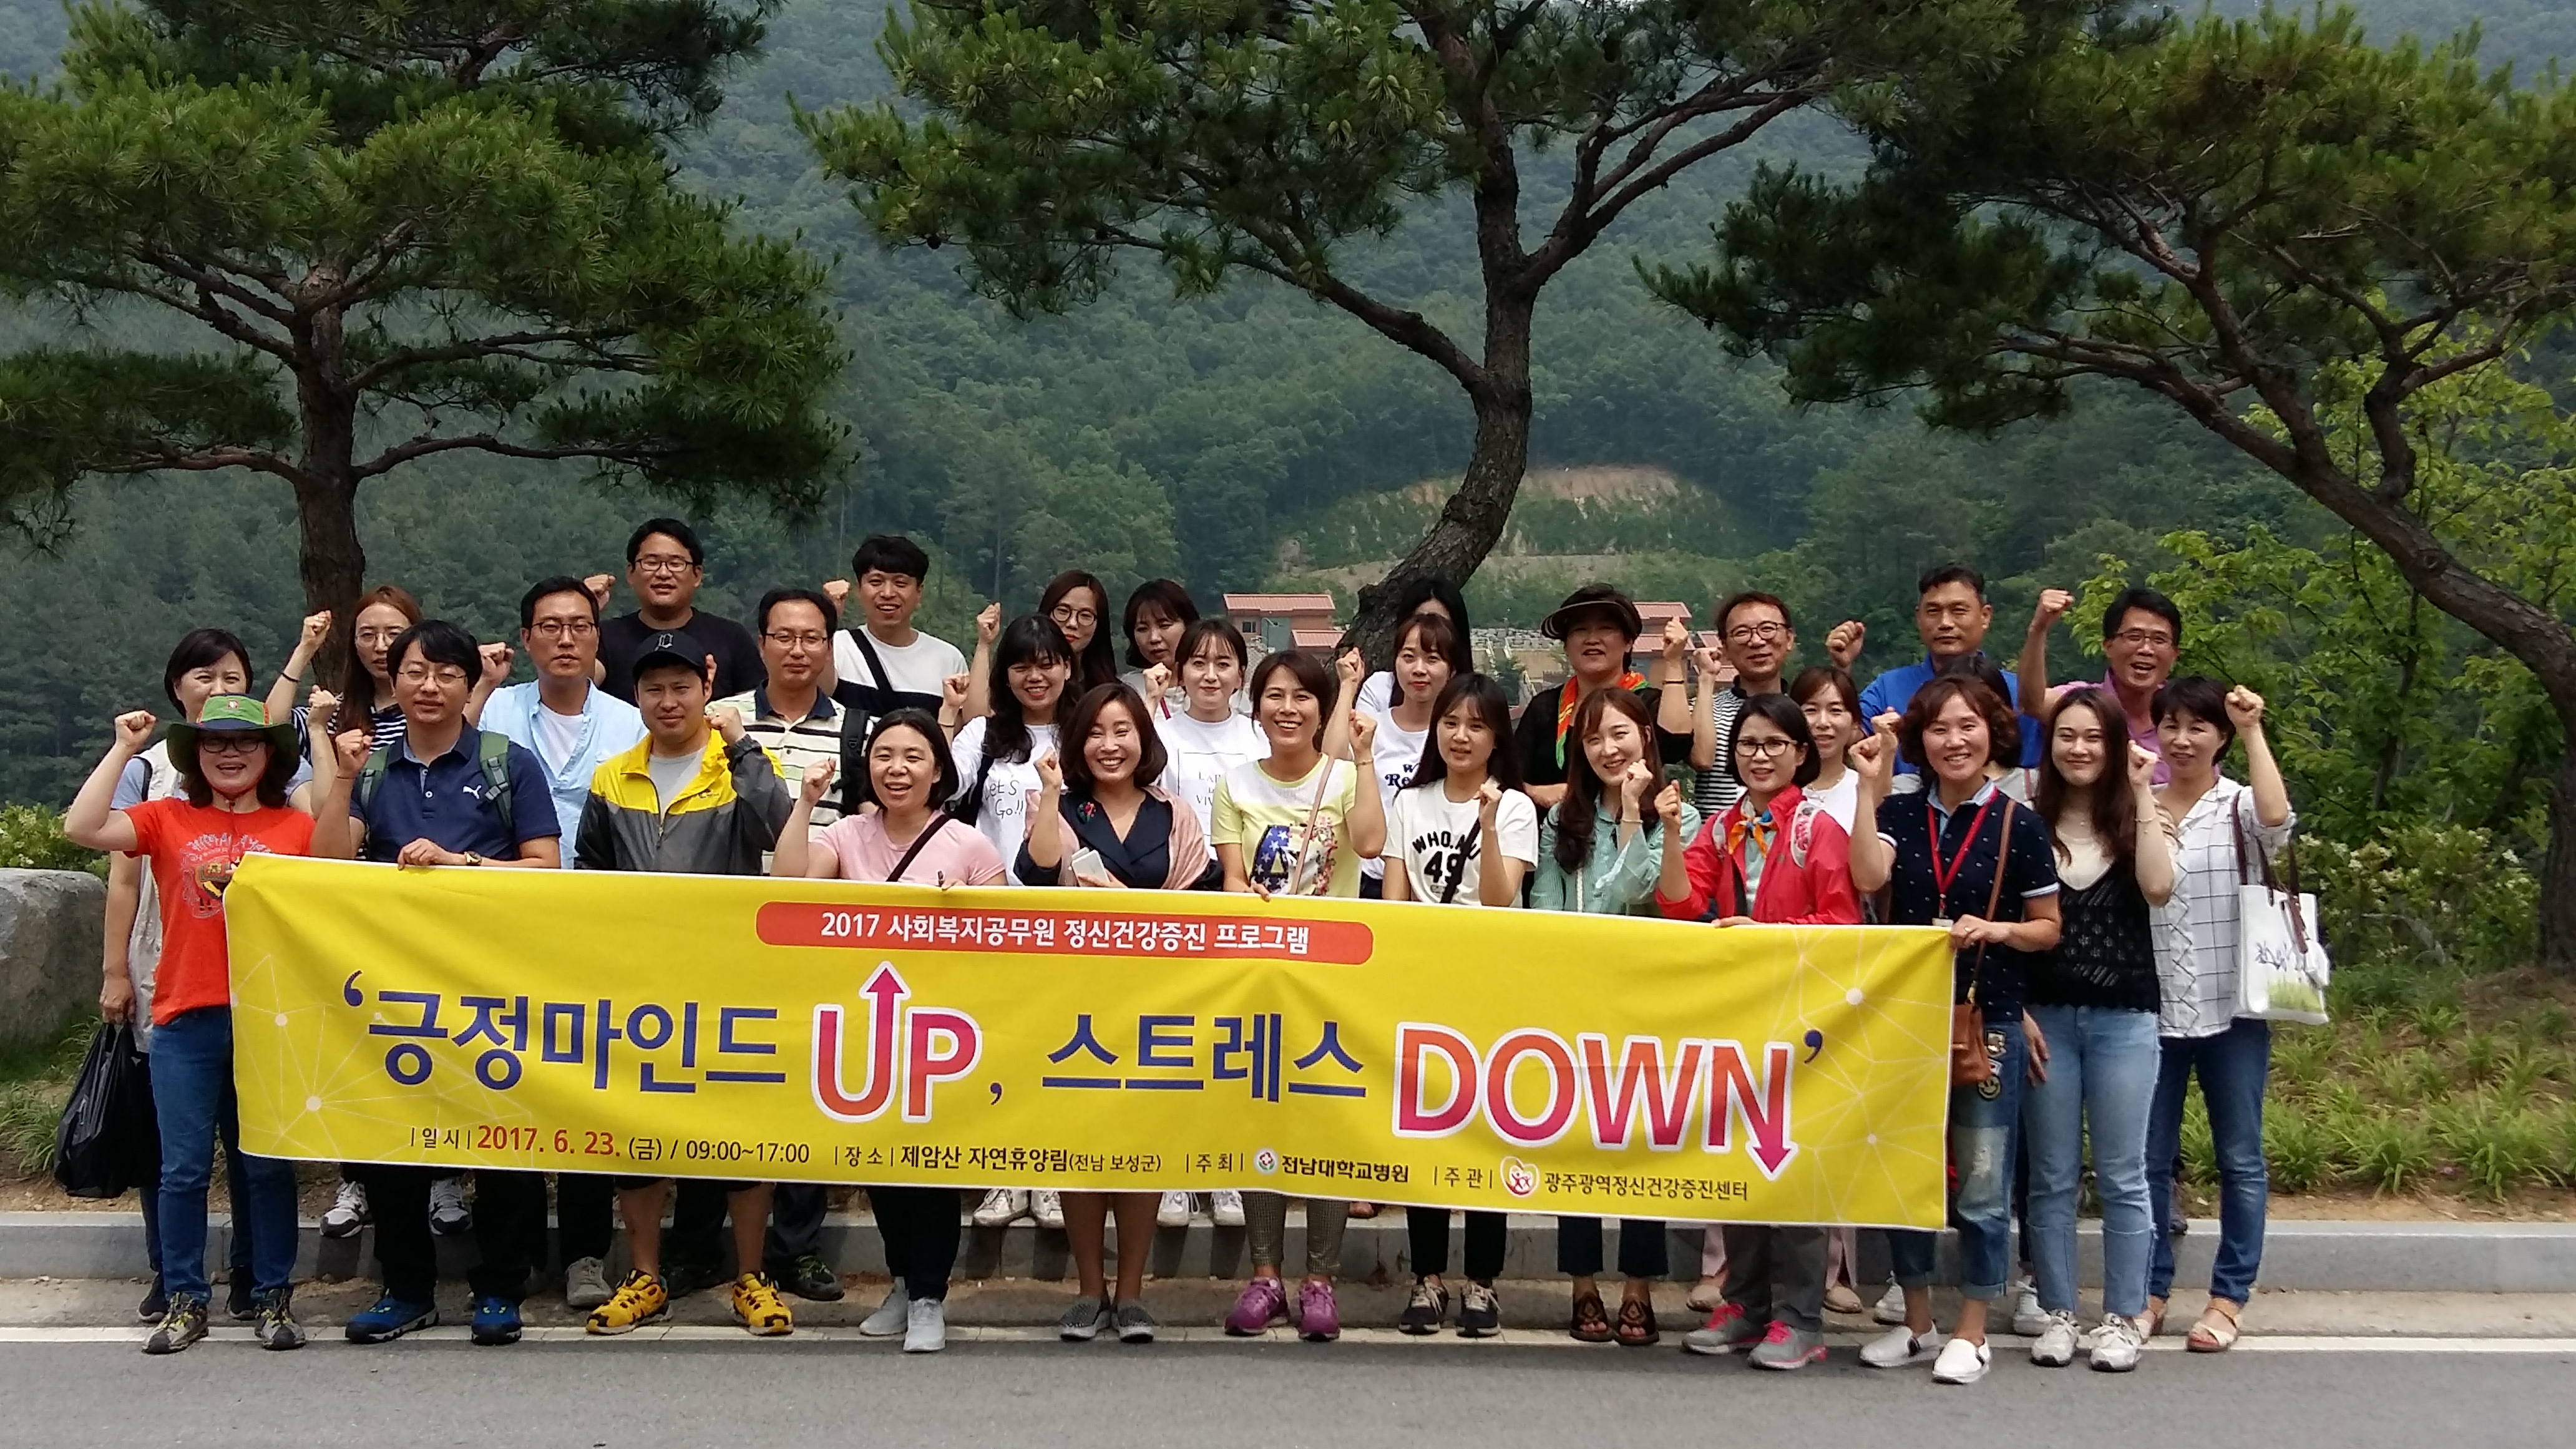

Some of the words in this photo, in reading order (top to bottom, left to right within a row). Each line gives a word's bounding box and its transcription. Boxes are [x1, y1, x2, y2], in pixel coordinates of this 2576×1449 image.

[995, 799, 1023, 819] Go!!
[821, 912, 880, 937] 2017
[886, 914, 1055, 946] 사회복지공무원
[1063, 919, 1206, 951] 정신건강증진
[1214, 924, 1309, 955] 프로그램
[1042, 1012, 1367, 1103] 스트레스
[477, 1125, 544, 1153] 2017.
[628, 1137, 662, 1161] (금)
[686, 1140, 810, 1163] 09:00~17:00
[900, 1145, 963, 1169] 제암산
[1110, 1154, 1161, 1173] 보성군)
[1282, 1155, 1409, 1183] 전남대학교병원
[1544, 1172, 1747, 1201] 광주광역정신건강증진센터
